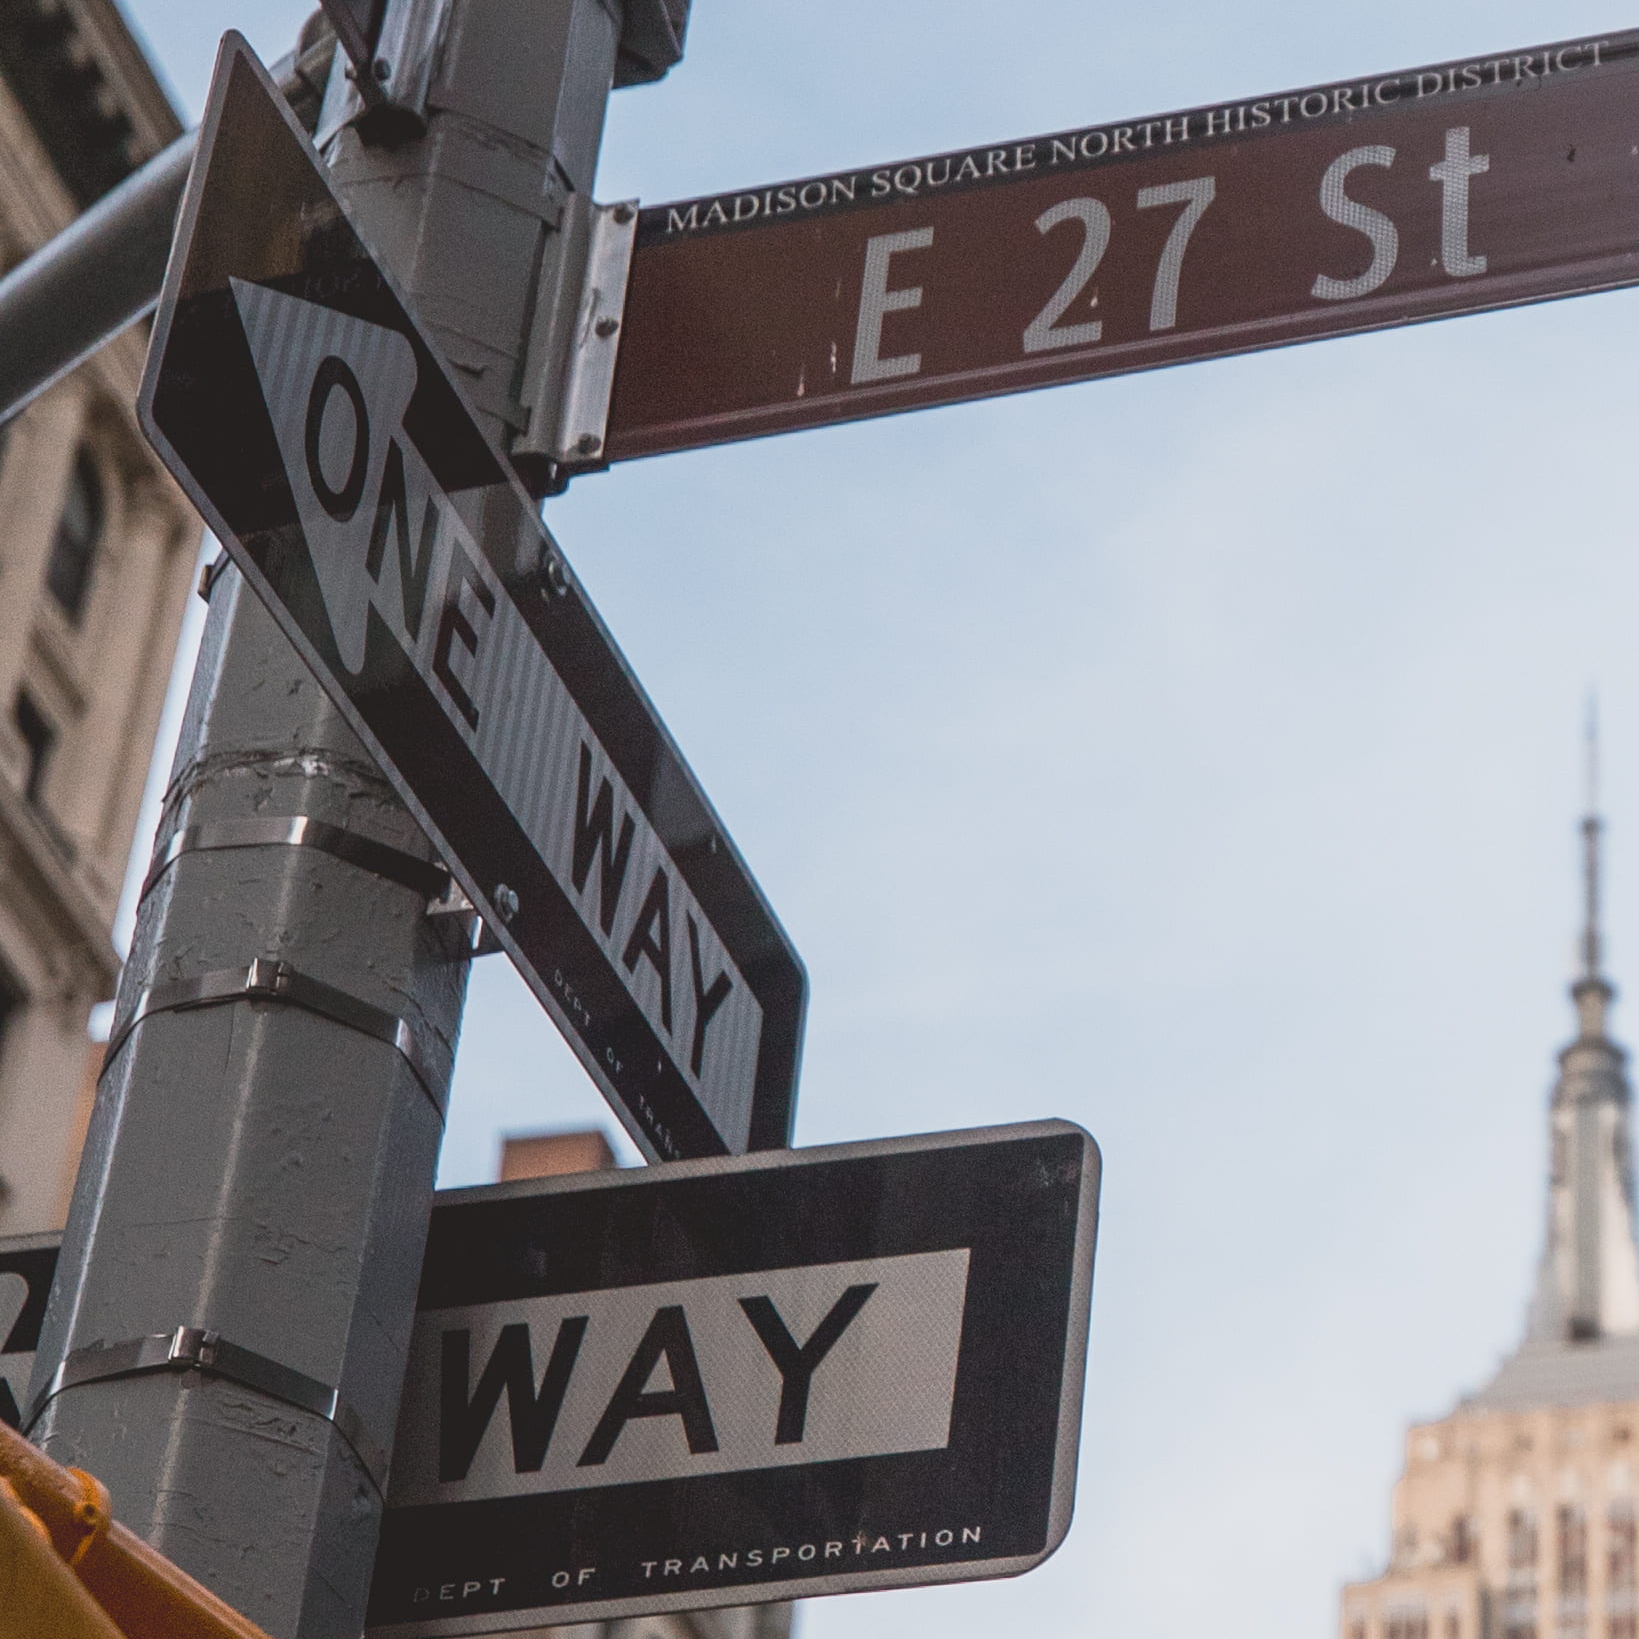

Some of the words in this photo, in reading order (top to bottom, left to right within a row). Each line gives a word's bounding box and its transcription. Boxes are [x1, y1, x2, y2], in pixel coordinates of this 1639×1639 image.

[665, 175, 858, 234] MADISON
[870, 143, 1037, 197] SQUARE
[1050, 115, 1190, 165] NORTH
[1204, 77, 1400, 138] HISTORIC
[1414, 40, 1611, 101] DISTRICT
[850, 226, 935, 386] E
[1022, 175, 1217, 353] 27
[1310, 126, 1491, 301] St
[304, 355, 495, 735] ONE
[570, 737, 734, 1083] WAY
[438, 1282, 880, 1484] WAY
[413, 1578, 506, 1603] DEPT
[551, 1567, 597, 1588] OF
[641, 1525, 984, 1579] TRANSPORTATION
